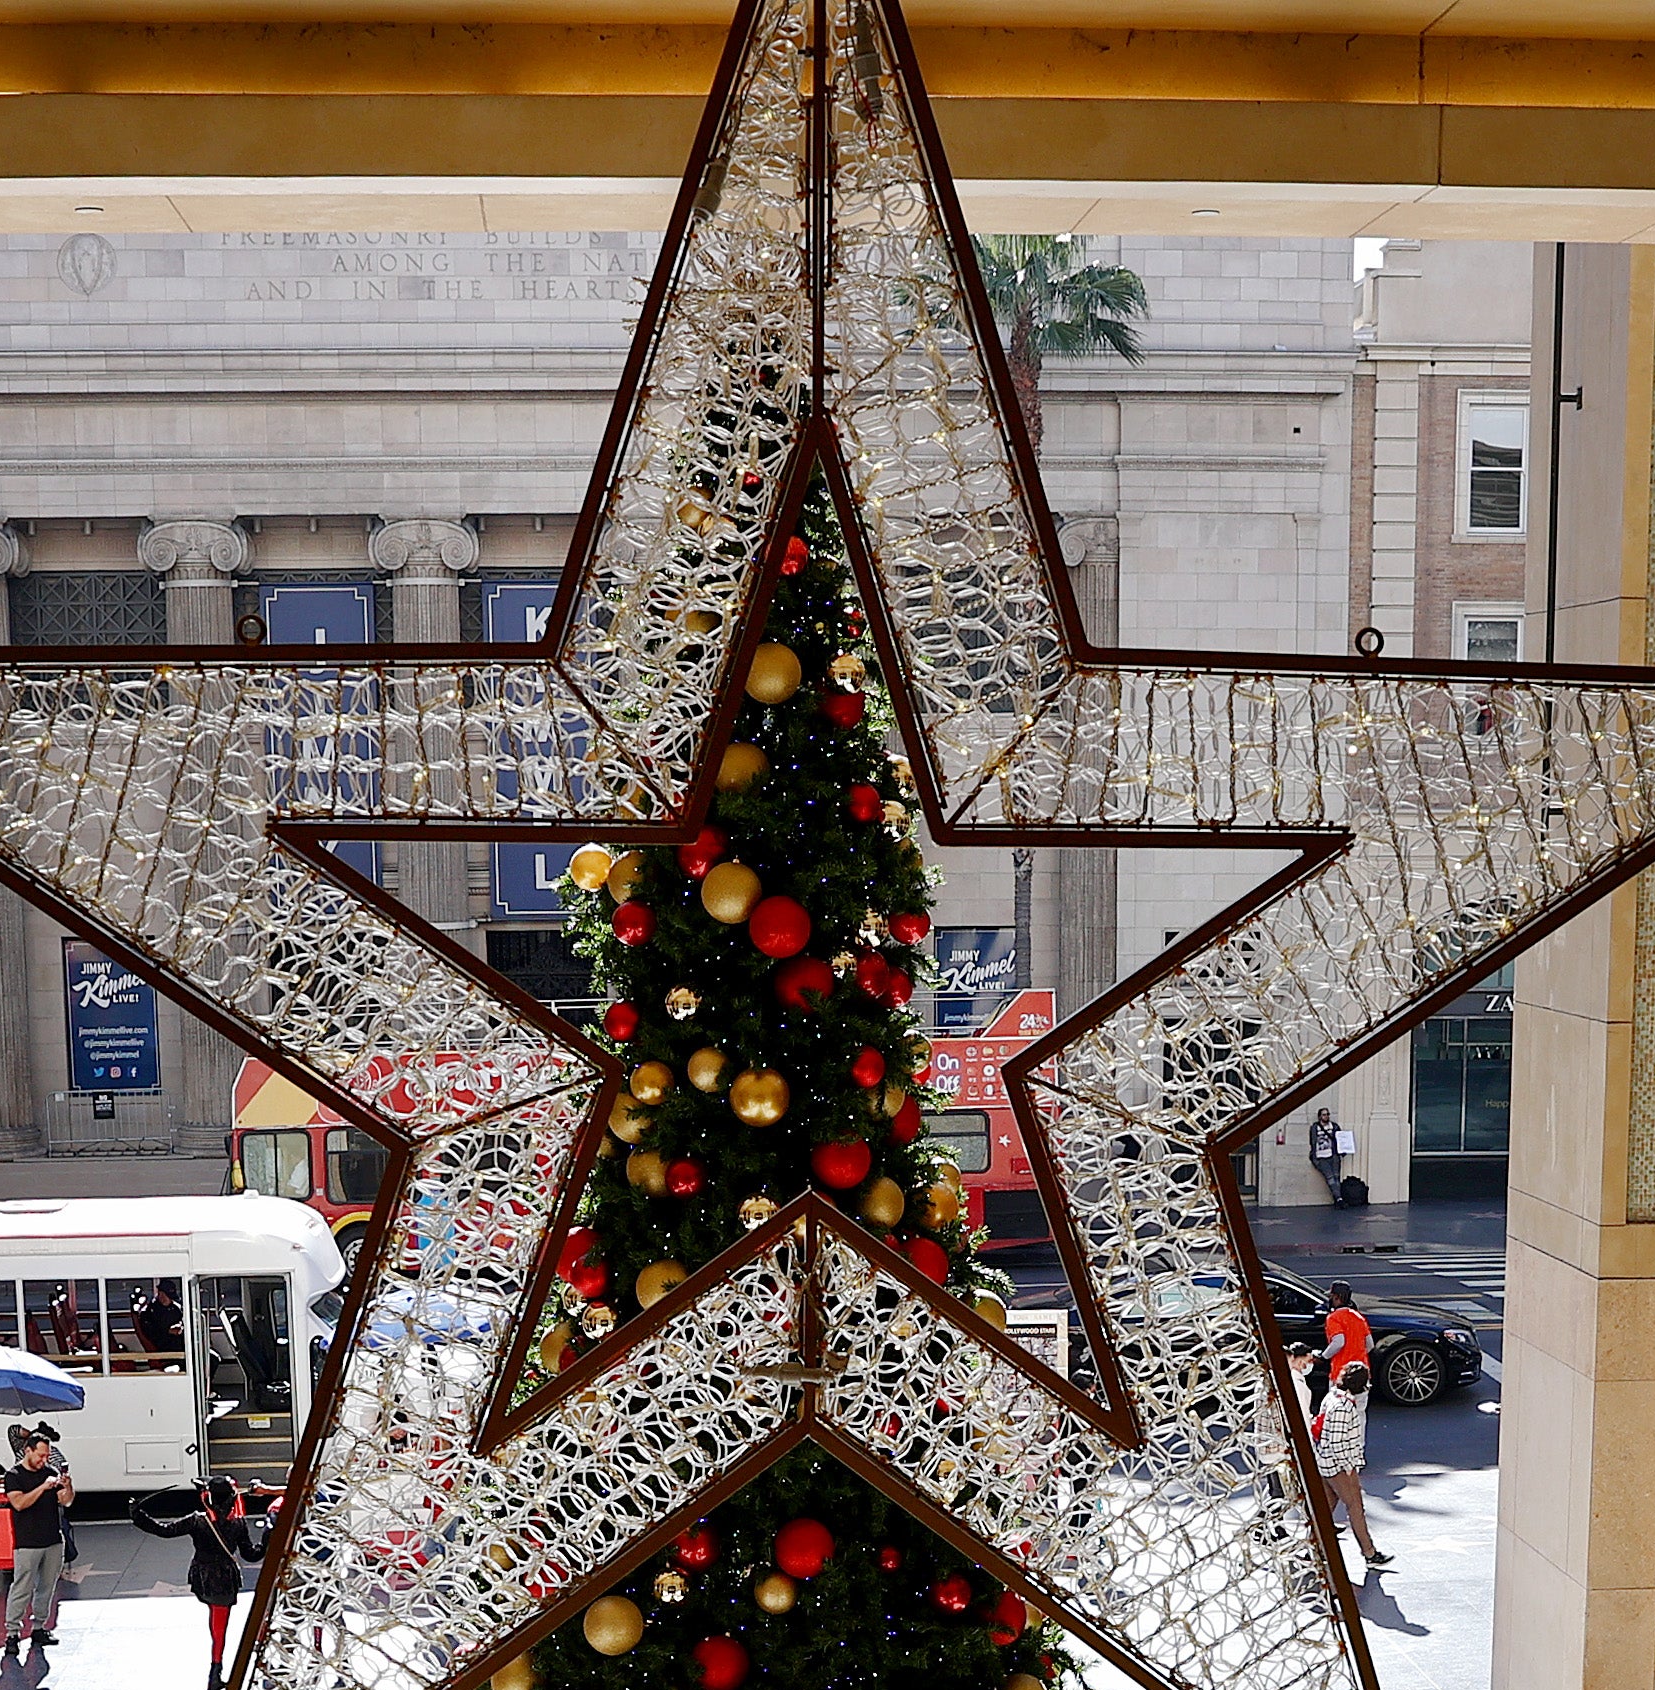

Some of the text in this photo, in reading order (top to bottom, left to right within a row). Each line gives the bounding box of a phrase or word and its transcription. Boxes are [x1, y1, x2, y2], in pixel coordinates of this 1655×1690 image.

[331, 253, 450, 273] AMONG
[486, 253, 548, 273] THE
[248, 280, 639, 301] AND IN THE HEARTS
[949, 950, 980, 962] JIMMY
[81, 962, 113, 975] JIMMY
[940, 950, 1016, 994] Kimmel
[71, 974, 146, 1008] Kimme
[979, 982, 1006, 990] LIVE!
[112, 994, 139, 1003] LIVE!
[937, 1053, 960, 1071] On
